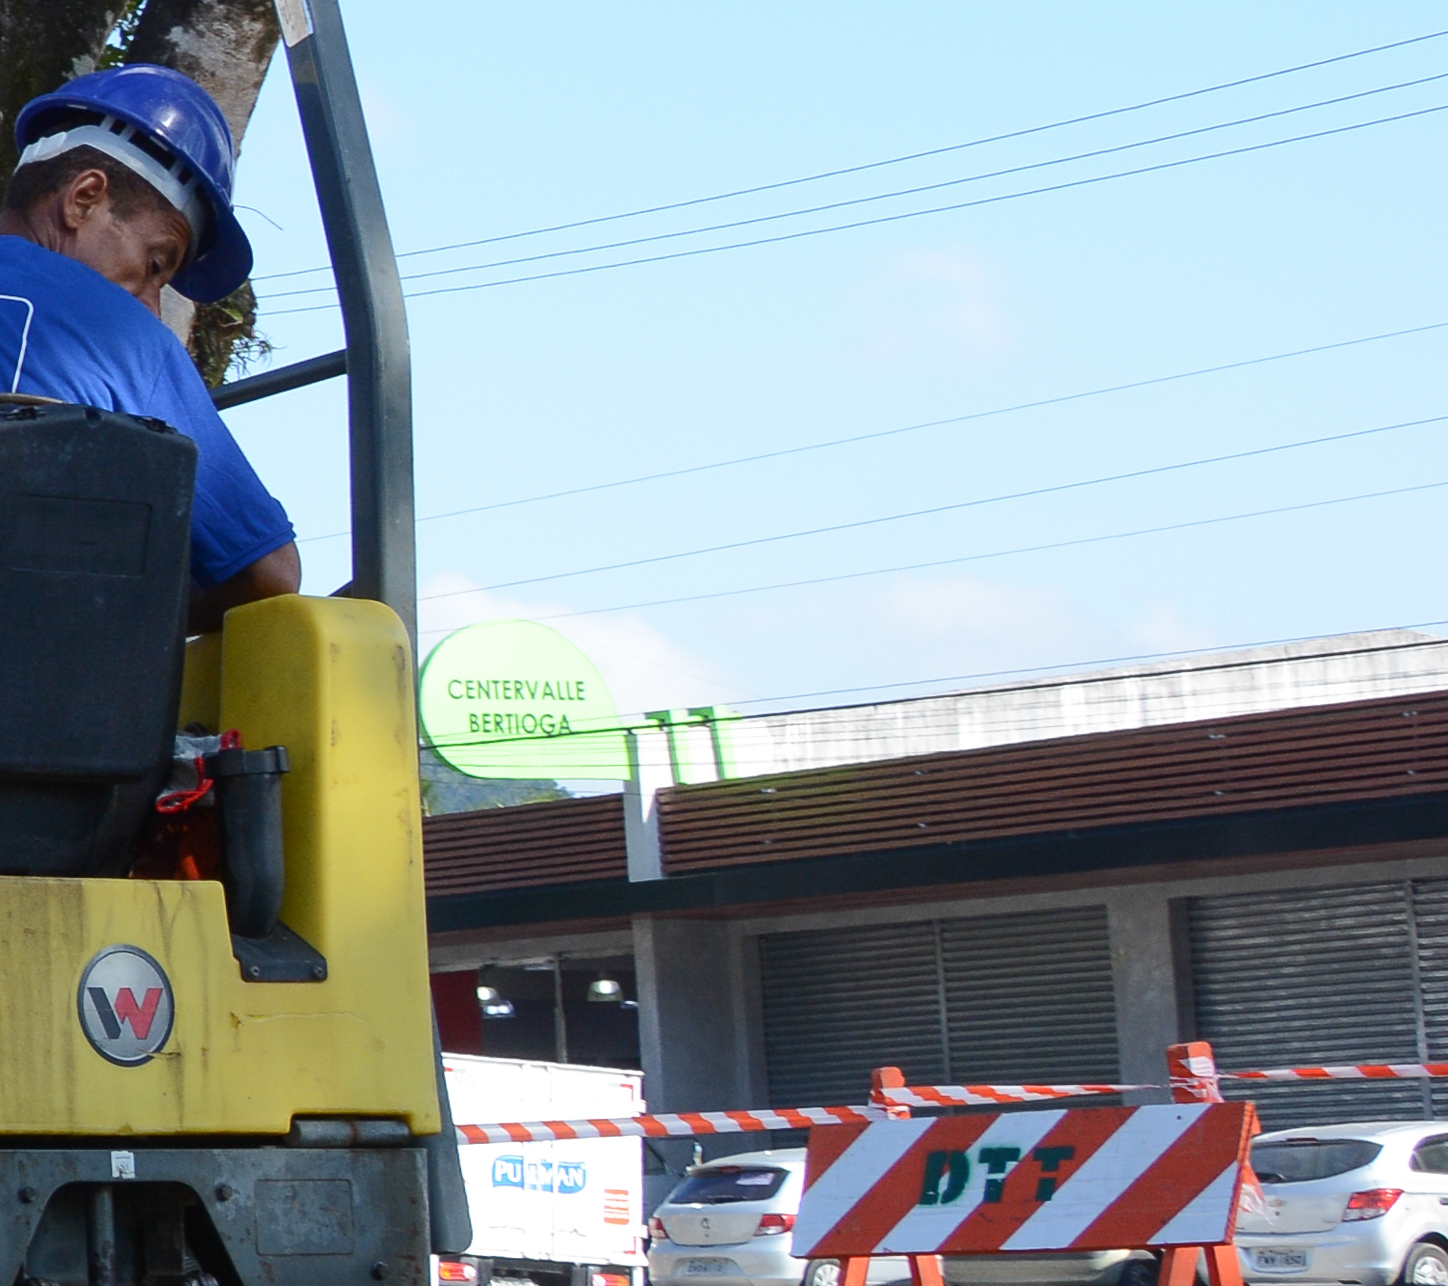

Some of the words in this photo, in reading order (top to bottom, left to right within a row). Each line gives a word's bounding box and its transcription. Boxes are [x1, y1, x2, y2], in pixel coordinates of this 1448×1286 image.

[447, 678, 586, 701] CENTERVALLE
[468, 712, 573, 736] BERTIOGA
[919, 1146, 1076, 1205] DTT
